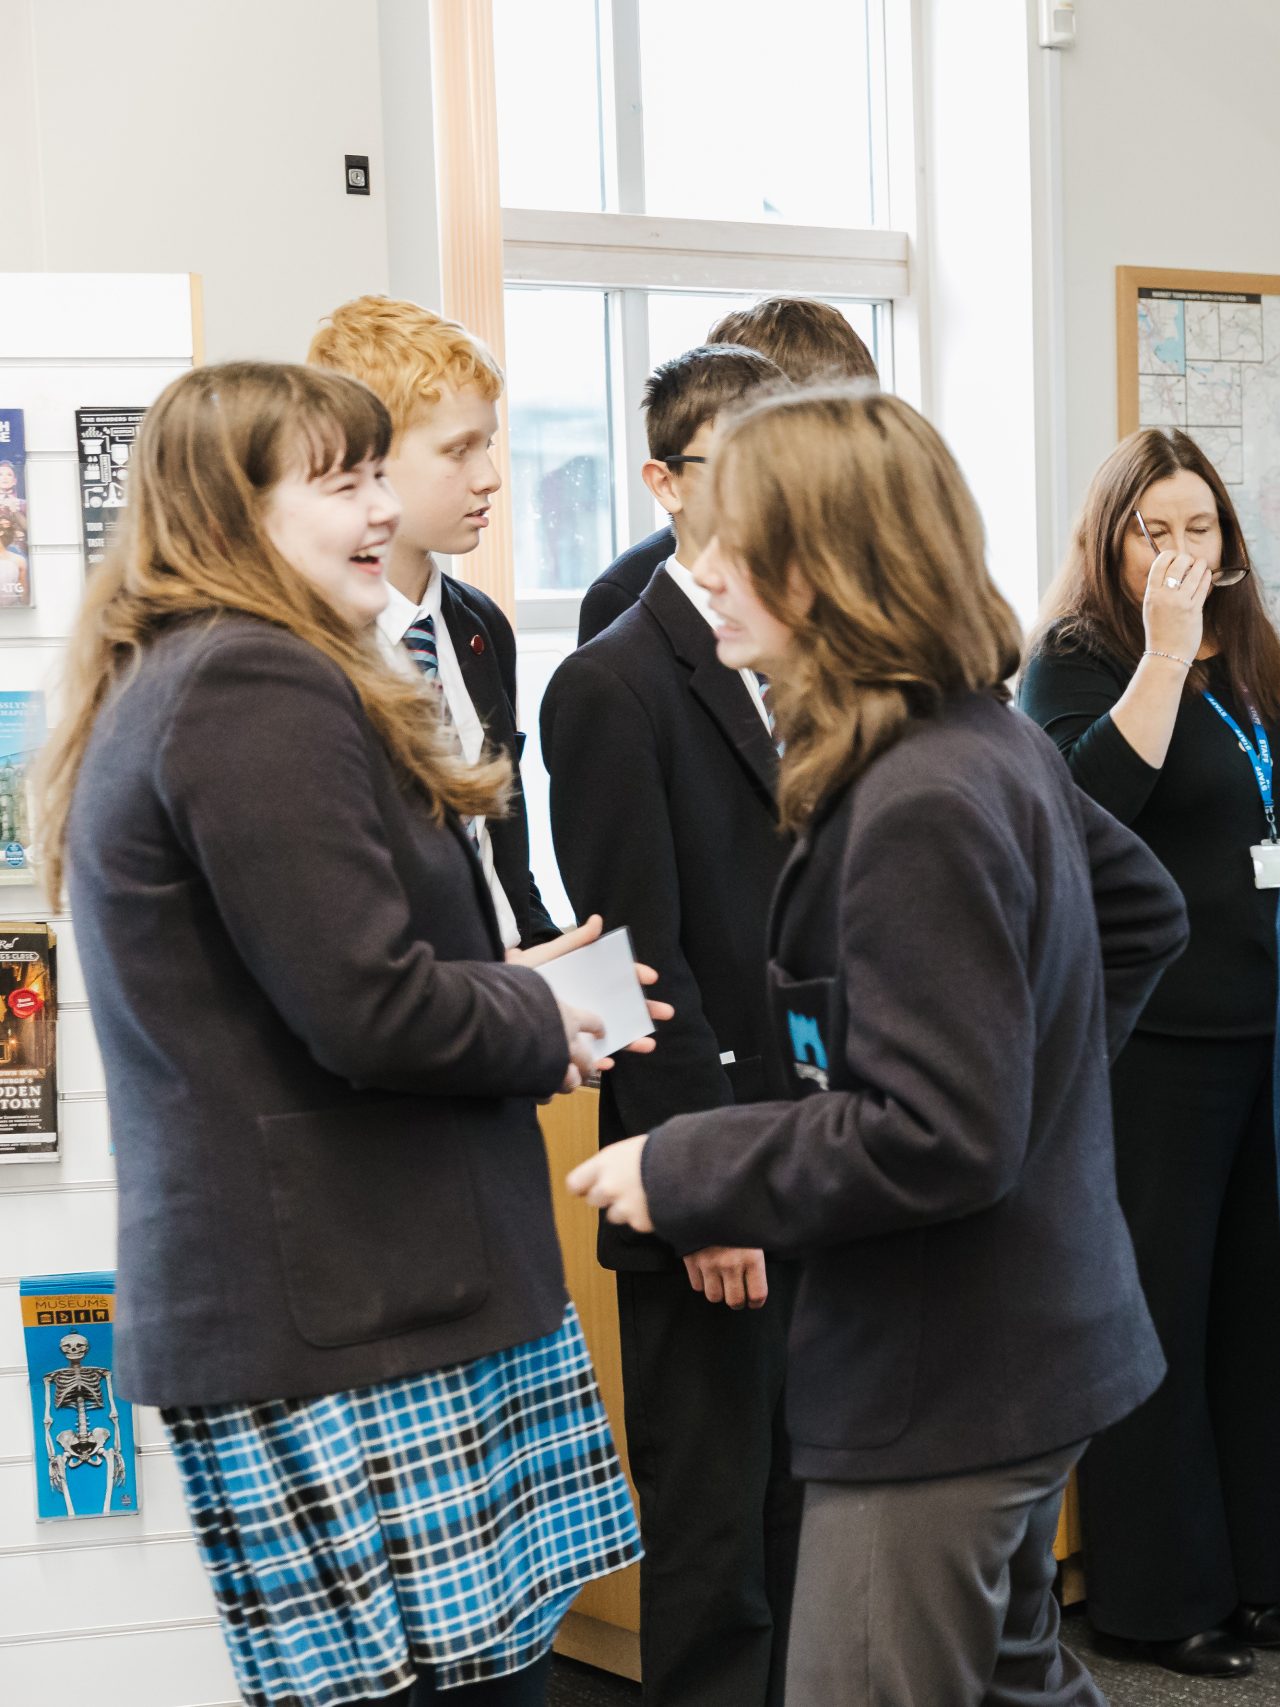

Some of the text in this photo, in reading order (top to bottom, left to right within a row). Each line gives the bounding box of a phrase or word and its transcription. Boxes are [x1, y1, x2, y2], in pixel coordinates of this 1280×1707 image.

[88, 538, 104, 547] TASTE
[1208, 697, 1228, 717] STAFF
[1234, 729, 1252, 751] STAFF
[1258, 739, 1269, 763] STAFF
[1255, 766, 1268, 791] STAFF
[35, 1299, 108, 1309] MUSEUMS
